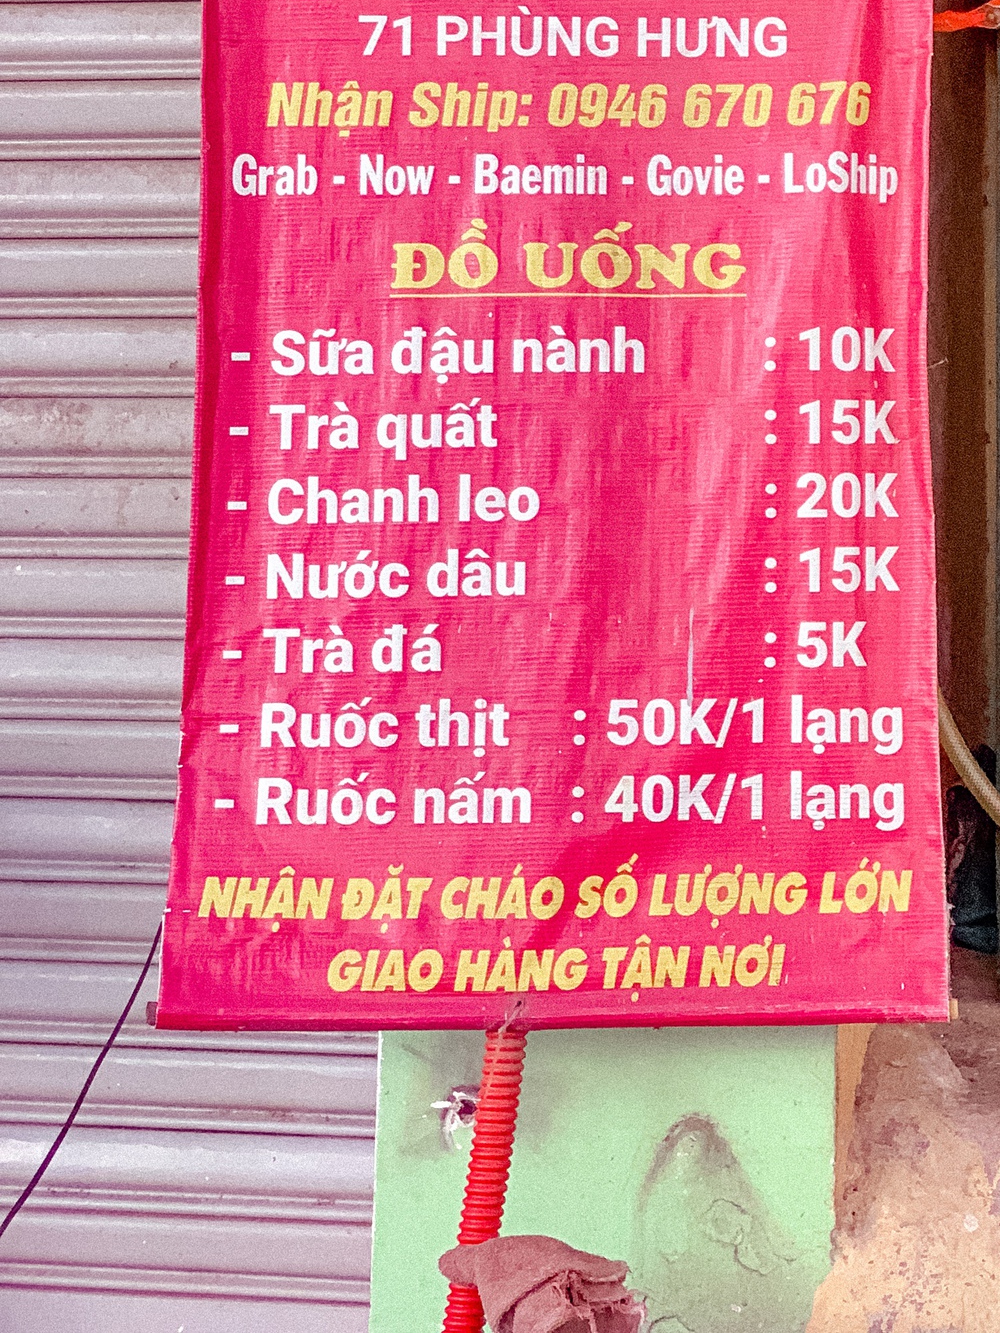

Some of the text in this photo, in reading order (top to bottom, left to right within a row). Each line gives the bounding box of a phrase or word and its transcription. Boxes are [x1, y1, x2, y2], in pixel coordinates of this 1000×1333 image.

[359, 6, 787, 57] 71 PHÙNG HƯNG
[267, 81, 870, 137] Nhận Ship: 0946 670 676
[233, 154, 317, 196] Grab
[359, 154, 434, 195] Now
[474, 154, 607, 195] Baemin
[647, 154, 744, 196] Govie
[781, 151, 898, 203] LoShip
[390, 218, 746, 289] ĐỒ UỐNG
[271, 329, 373, 376] Sữa
[391, 327, 493, 384] đậu
[513, 325, 644, 372] nành
[799, 326, 895, 372] 10K
[269, 401, 359, 450] Trà
[376, 398, 497, 460] quất
[799, 400, 900, 444] 15K
[268, 475, 438, 525] Chanh
[458, 474, 539, 521] leo
[796, 472, 899, 518] 20K
[266, 550, 409, 599] Nước
[427, 548, 525, 597] dâu
[799, 546, 900, 592] 15K
[262, 624, 353, 673] Trà
[371, 624, 441, 672] đá
[797, 621, 866, 668] 5K
[260, 697, 398, 749] Ruốc
[415, 698, 509, 757] thịt
[607, 698, 763, 745] 50K/1
[791, 695, 903, 755] lạng
[255, 772, 395, 825] Ruốc
[414, 771, 531, 824] nấm
[605, 774, 762, 823] 40K/1
[790, 771, 904, 831] lạng
[198, 854, 912, 933] NHẬN ĐẶT CHÁO SỐ LƯỢNG LỚN
[327, 934, 786, 1001] GIAO HÀNG TẬN NƠI
